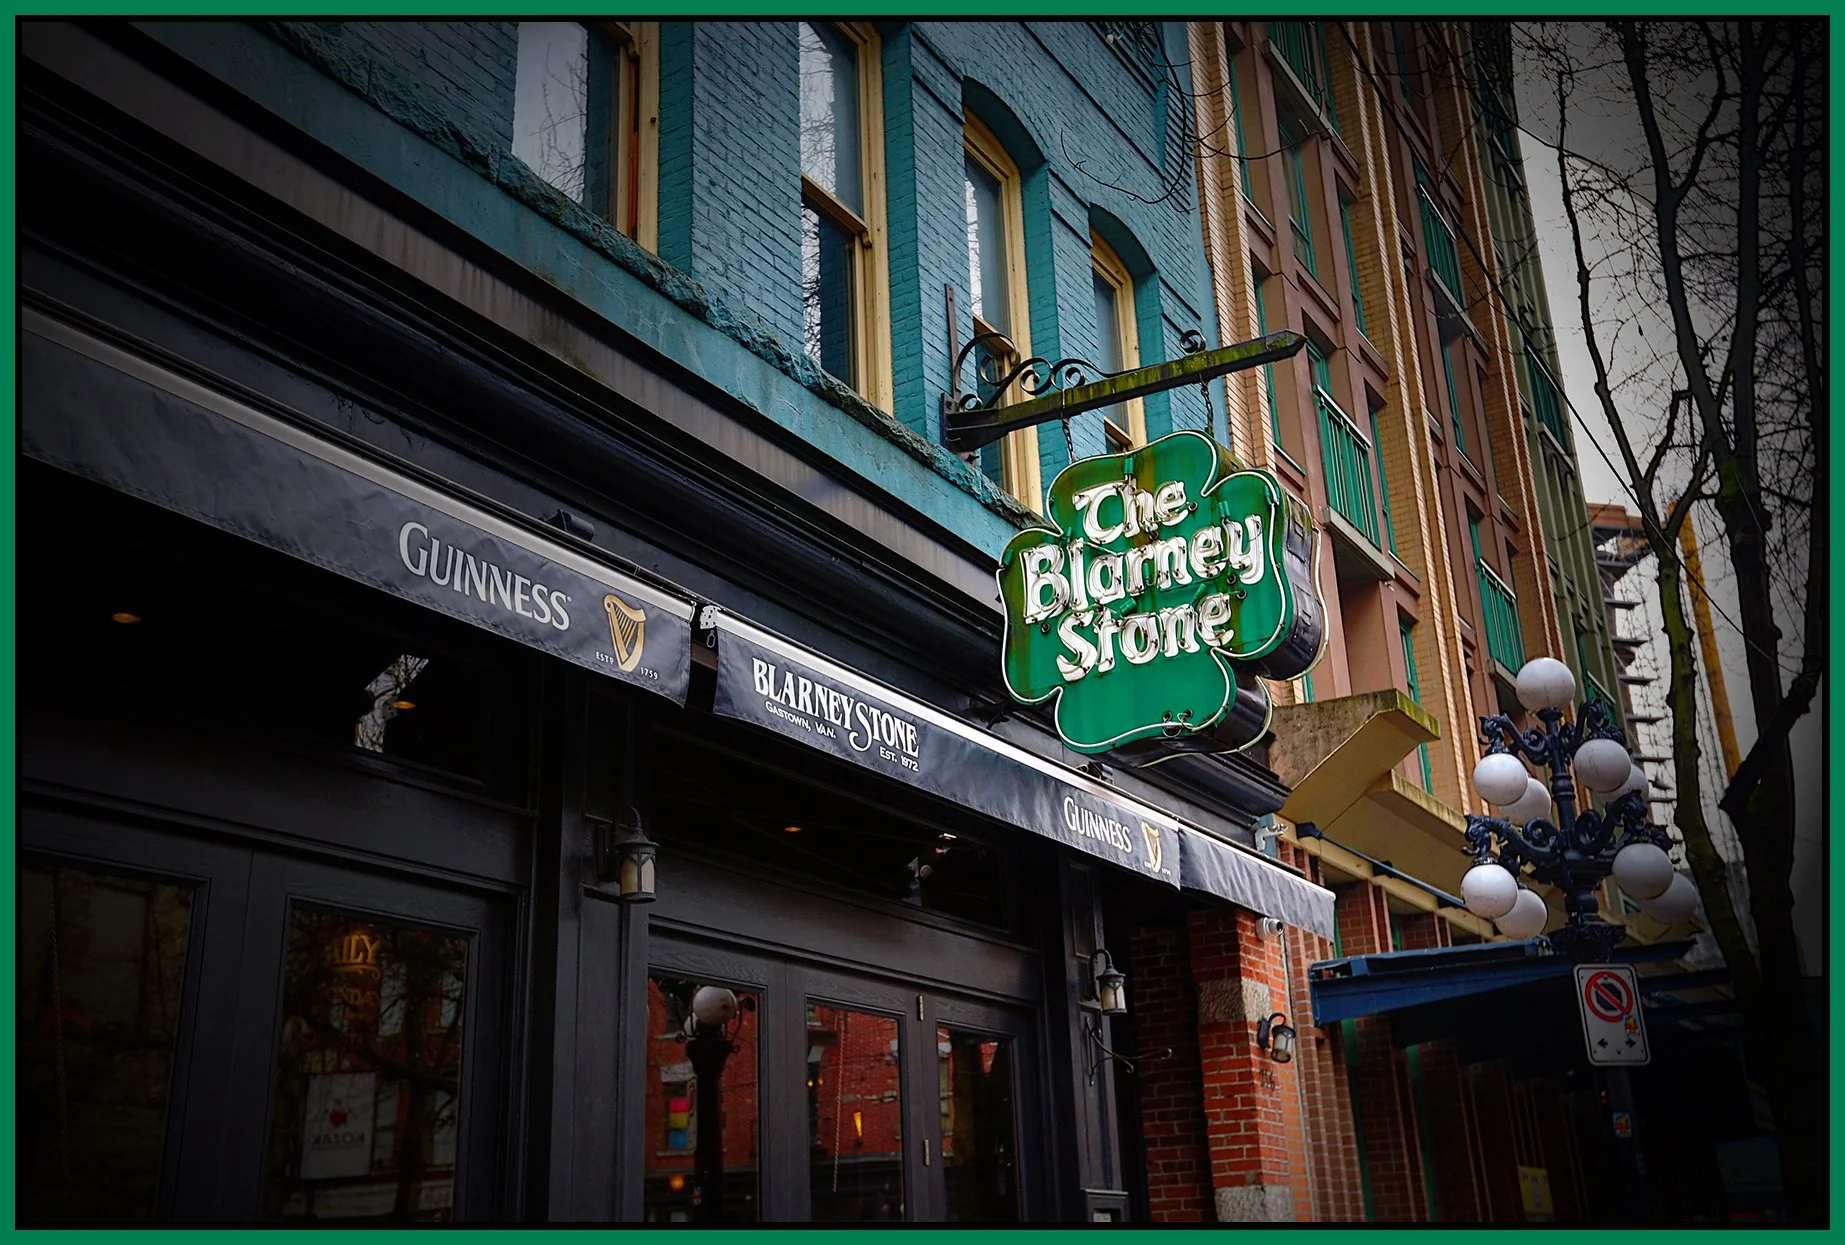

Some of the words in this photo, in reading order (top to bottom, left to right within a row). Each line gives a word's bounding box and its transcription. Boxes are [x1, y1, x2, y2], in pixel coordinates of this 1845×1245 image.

[1072, 480, 1189, 544] The
[399, 521, 571, 631] GUINNESS
[1019, 514, 1265, 624] Blarney
[1055, 592, 1235, 682] Stone
[640, 667, 658, 680] 1759
[752, 657, 855, 731] BLARNEY
[848, 702, 920, 758] STONE
[765, 701, 812, 732] GASTOWN,
[815, 721, 837, 739] VAN.
[879, 746, 898, 763] EST.
[900, 755, 920, 772] 1972
[1063, 796, 1132, 854] GUINNESS
